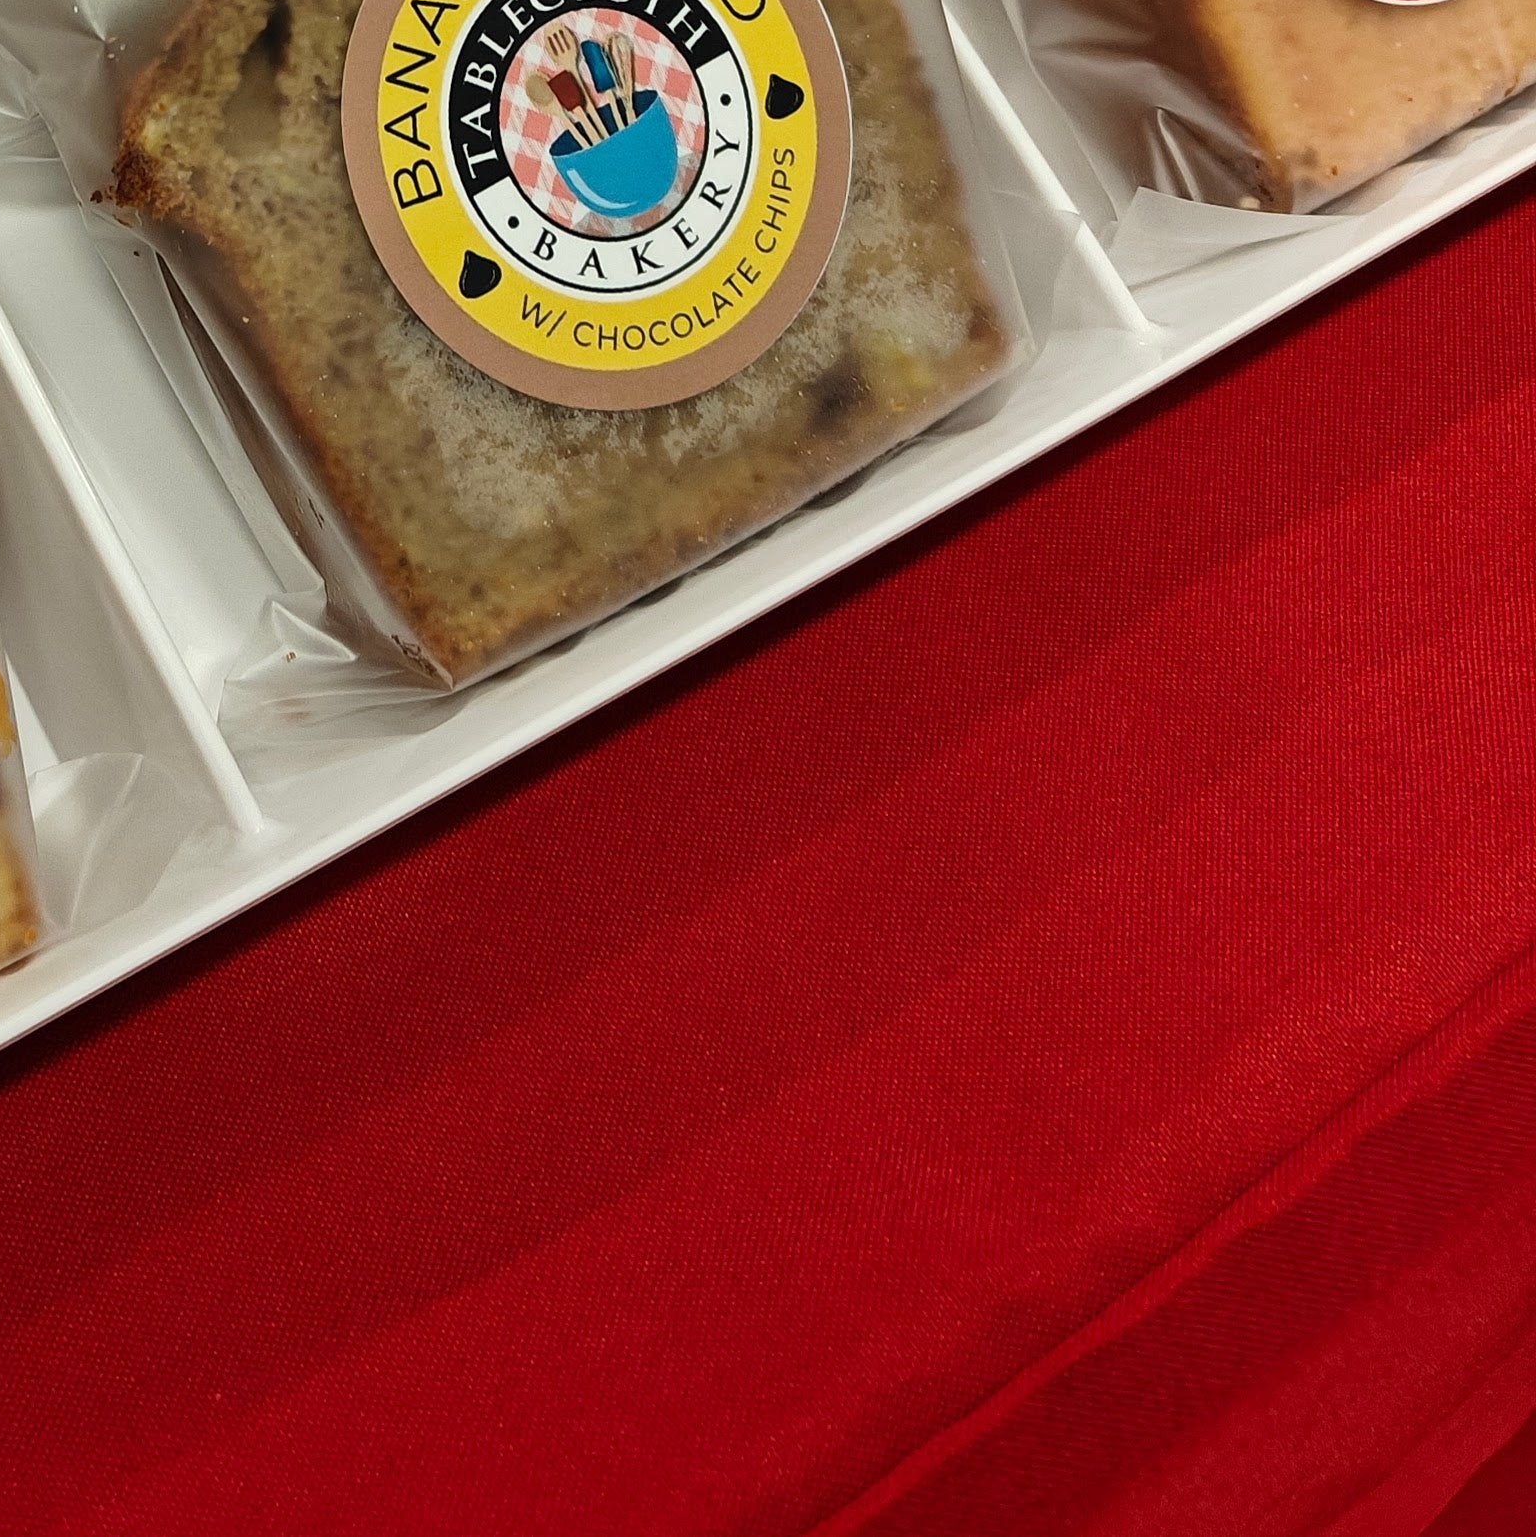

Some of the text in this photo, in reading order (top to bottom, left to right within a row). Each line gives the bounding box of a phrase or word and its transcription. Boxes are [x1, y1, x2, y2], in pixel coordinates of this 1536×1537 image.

[520, 146, 795, 351] W/ CHOCOLATE CHIPS
[531, 135, 742, 279] BAKERY
